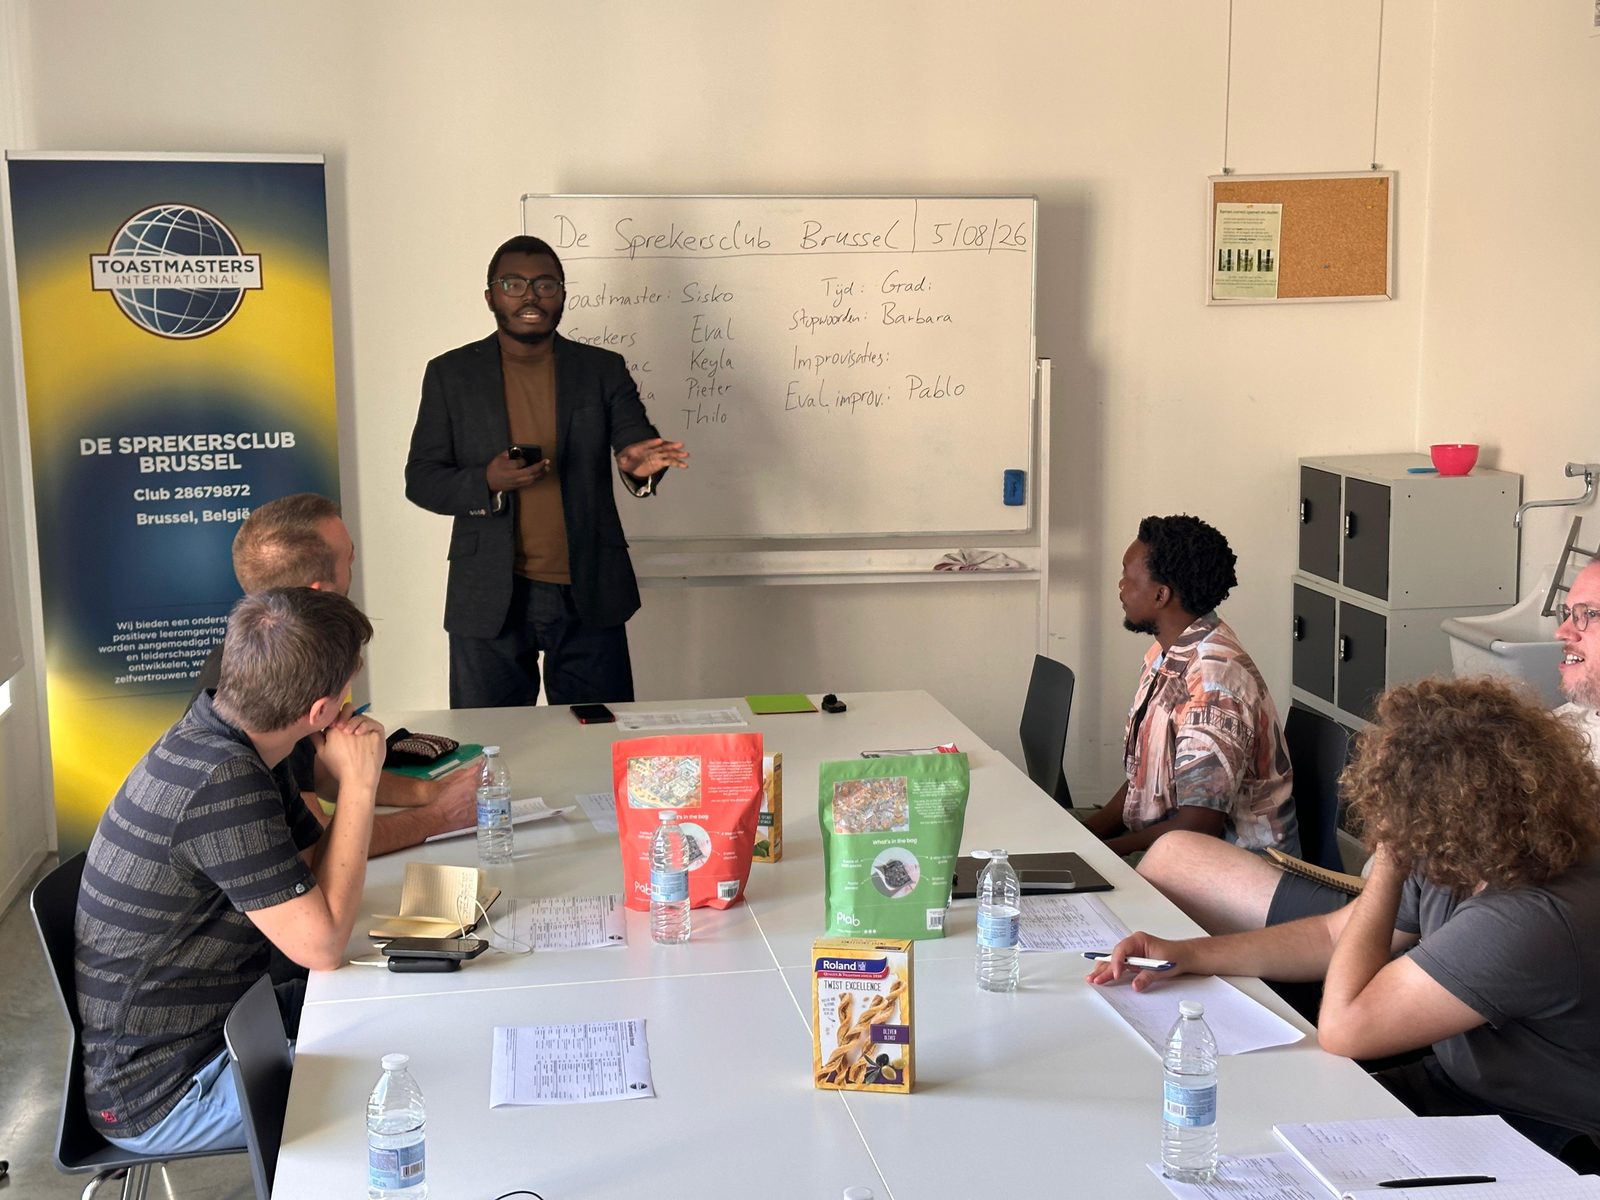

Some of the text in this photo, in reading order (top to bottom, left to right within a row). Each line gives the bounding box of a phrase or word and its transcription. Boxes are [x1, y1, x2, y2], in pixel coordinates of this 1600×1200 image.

[554, 215, 1027, 260] De Sprekersclub Brussel 5/08/26
[98, 260, 254, 273] TOASTMASTERS
[116, 274, 238, 285] INTERNATIONAL
[681, 281, 734, 303] Sisko
[881, 301, 953, 325] Barbara
[691, 314, 735, 344] Eval
[690, 348, 735, 377] Keyla
[685, 377, 733, 400] Pieter
[905, 374, 965, 400] Pablo
[681, 403, 727, 430] Thilo
[79, 431, 296, 456] DE SPREKERSCLUB
[139, 453, 242, 473] BRUSSEL
[133, 484, 251, 501] Club 28679872
[136, 510, 199, 525] Brussel,
[117, 621, 133, 631] Wij
[135, 619, 169, 629] bieden
[192, 616, 230, 625] onderst
[113, 627, 225, 642] positieve leeromgeving
[99, 637, 224, 653] worden aangemoedigd hu
[141, 649, 212, 660] leiderschapsva
[128, 660, 190, 672] ontwikkelen,
[115, 671, 187, 684] zelfvertrouwen
[823, 960, 857, 970] Roland
[824, 980, 881, 992] TWIST EXCELLENCE
